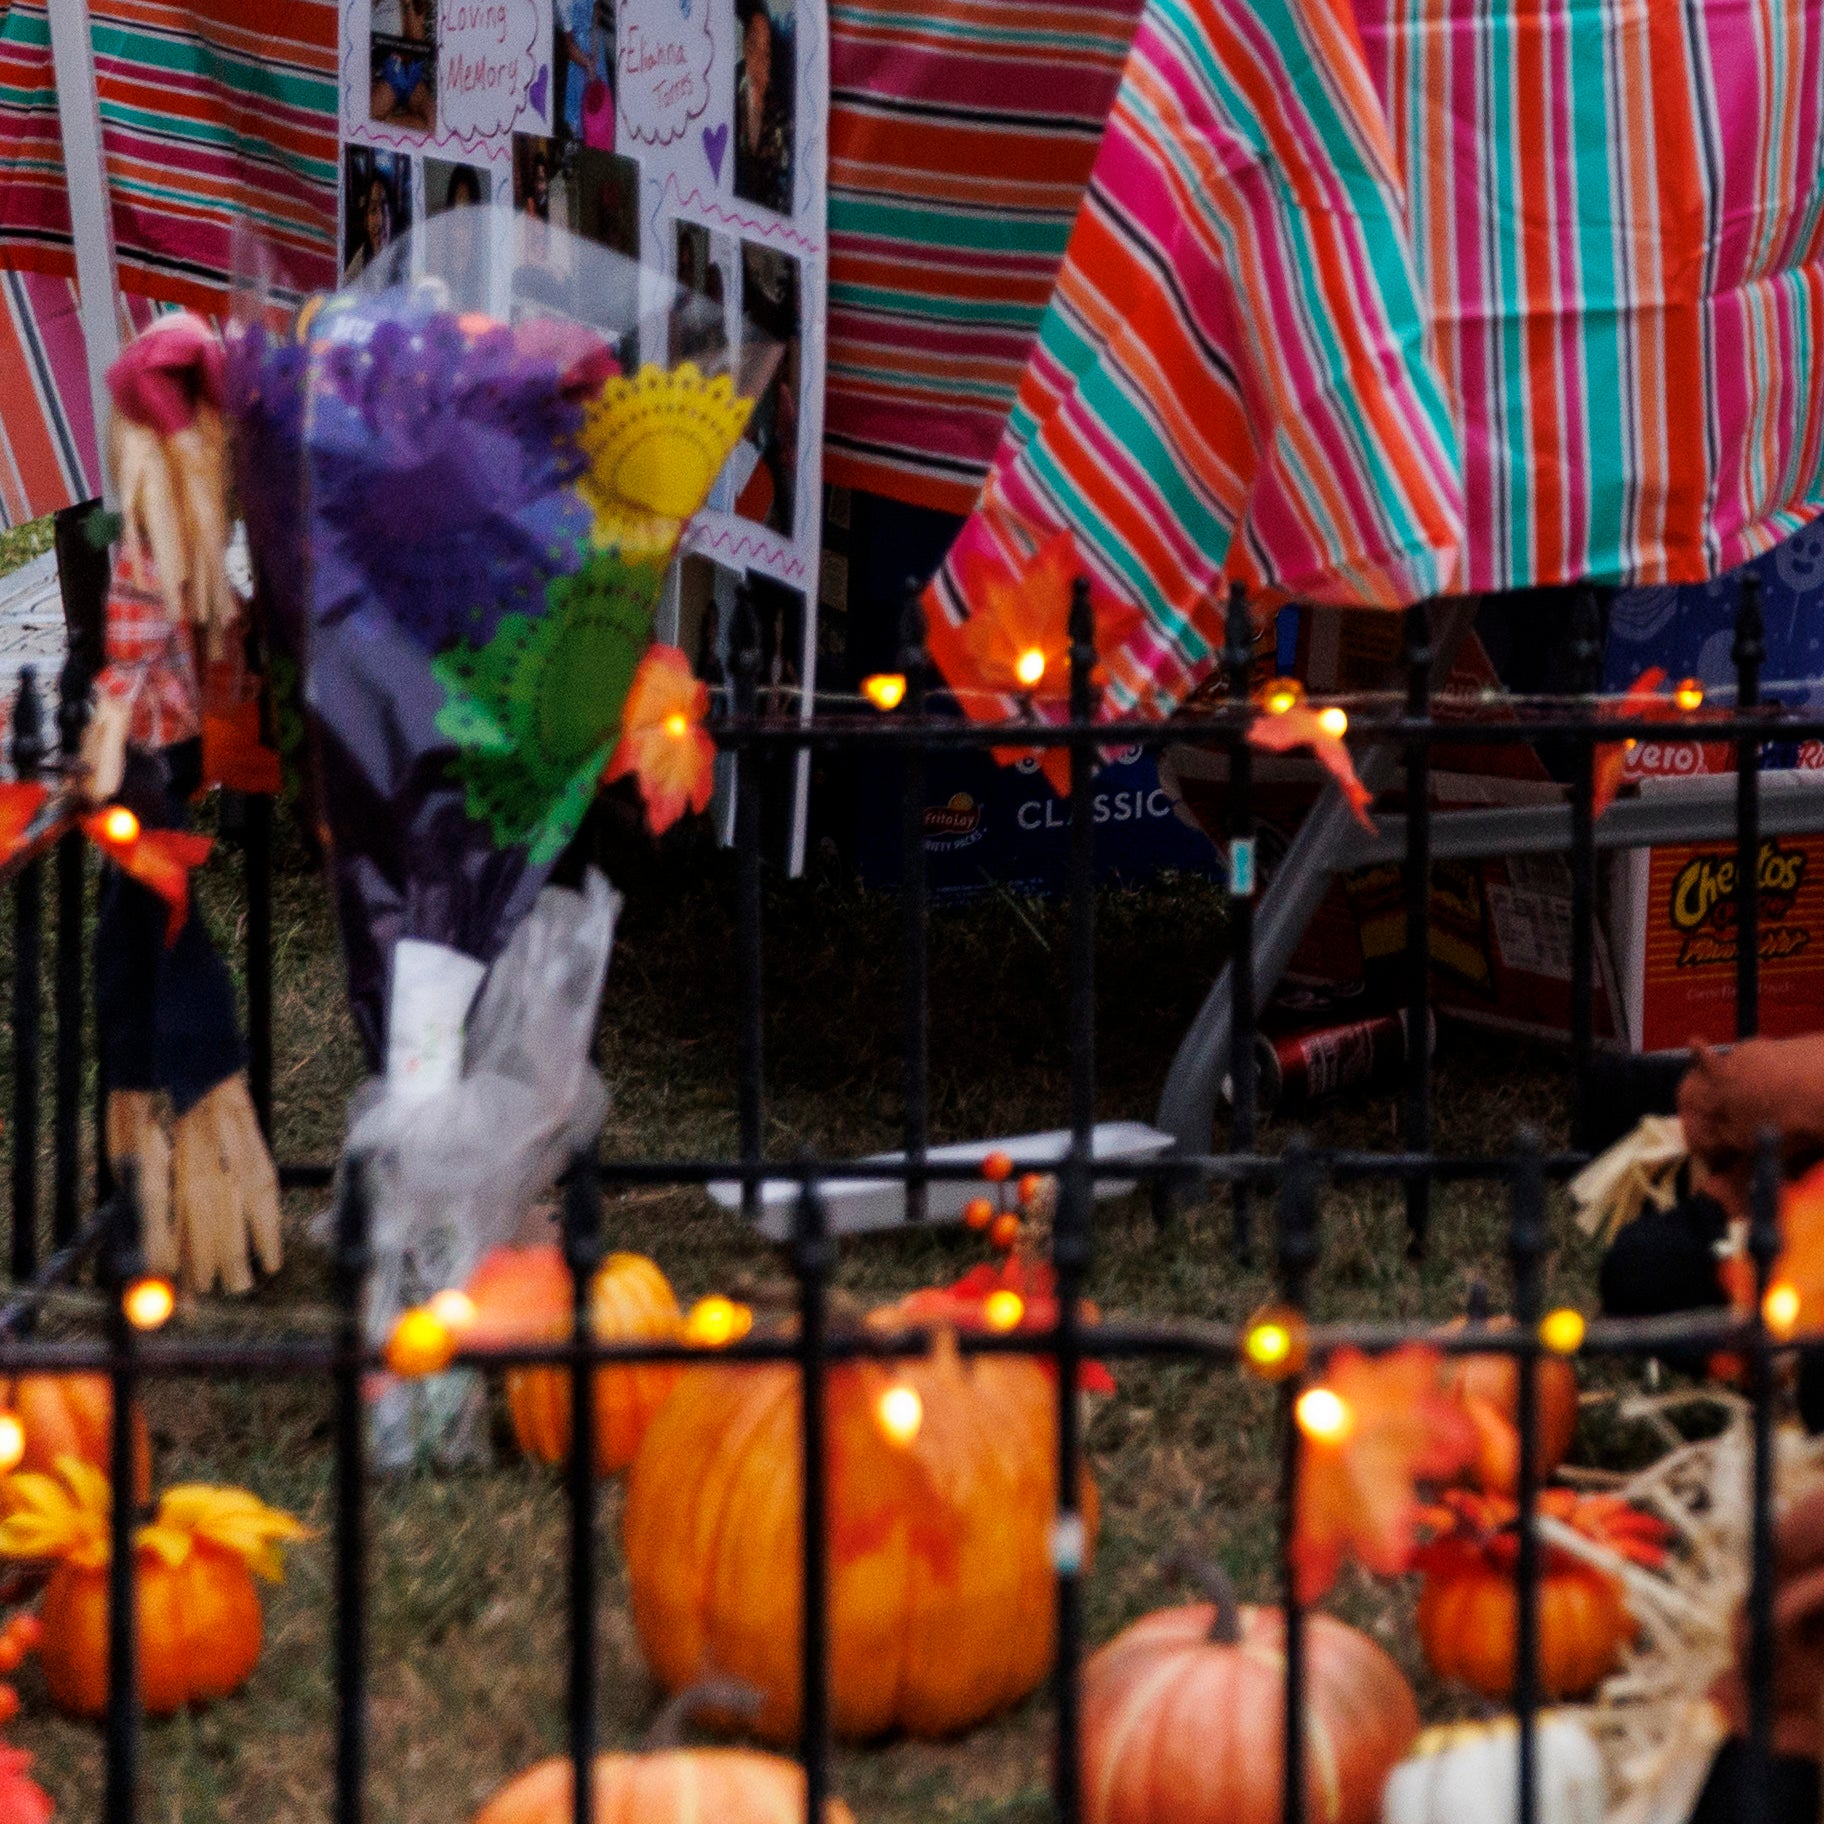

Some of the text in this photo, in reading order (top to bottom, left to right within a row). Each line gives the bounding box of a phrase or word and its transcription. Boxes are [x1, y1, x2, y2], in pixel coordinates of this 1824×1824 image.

[1625, 740, 1695, 772] Vero
[1016, 788, 1172, 830] CLSSIC
[1674, 842, 1804, 926] Chetos
